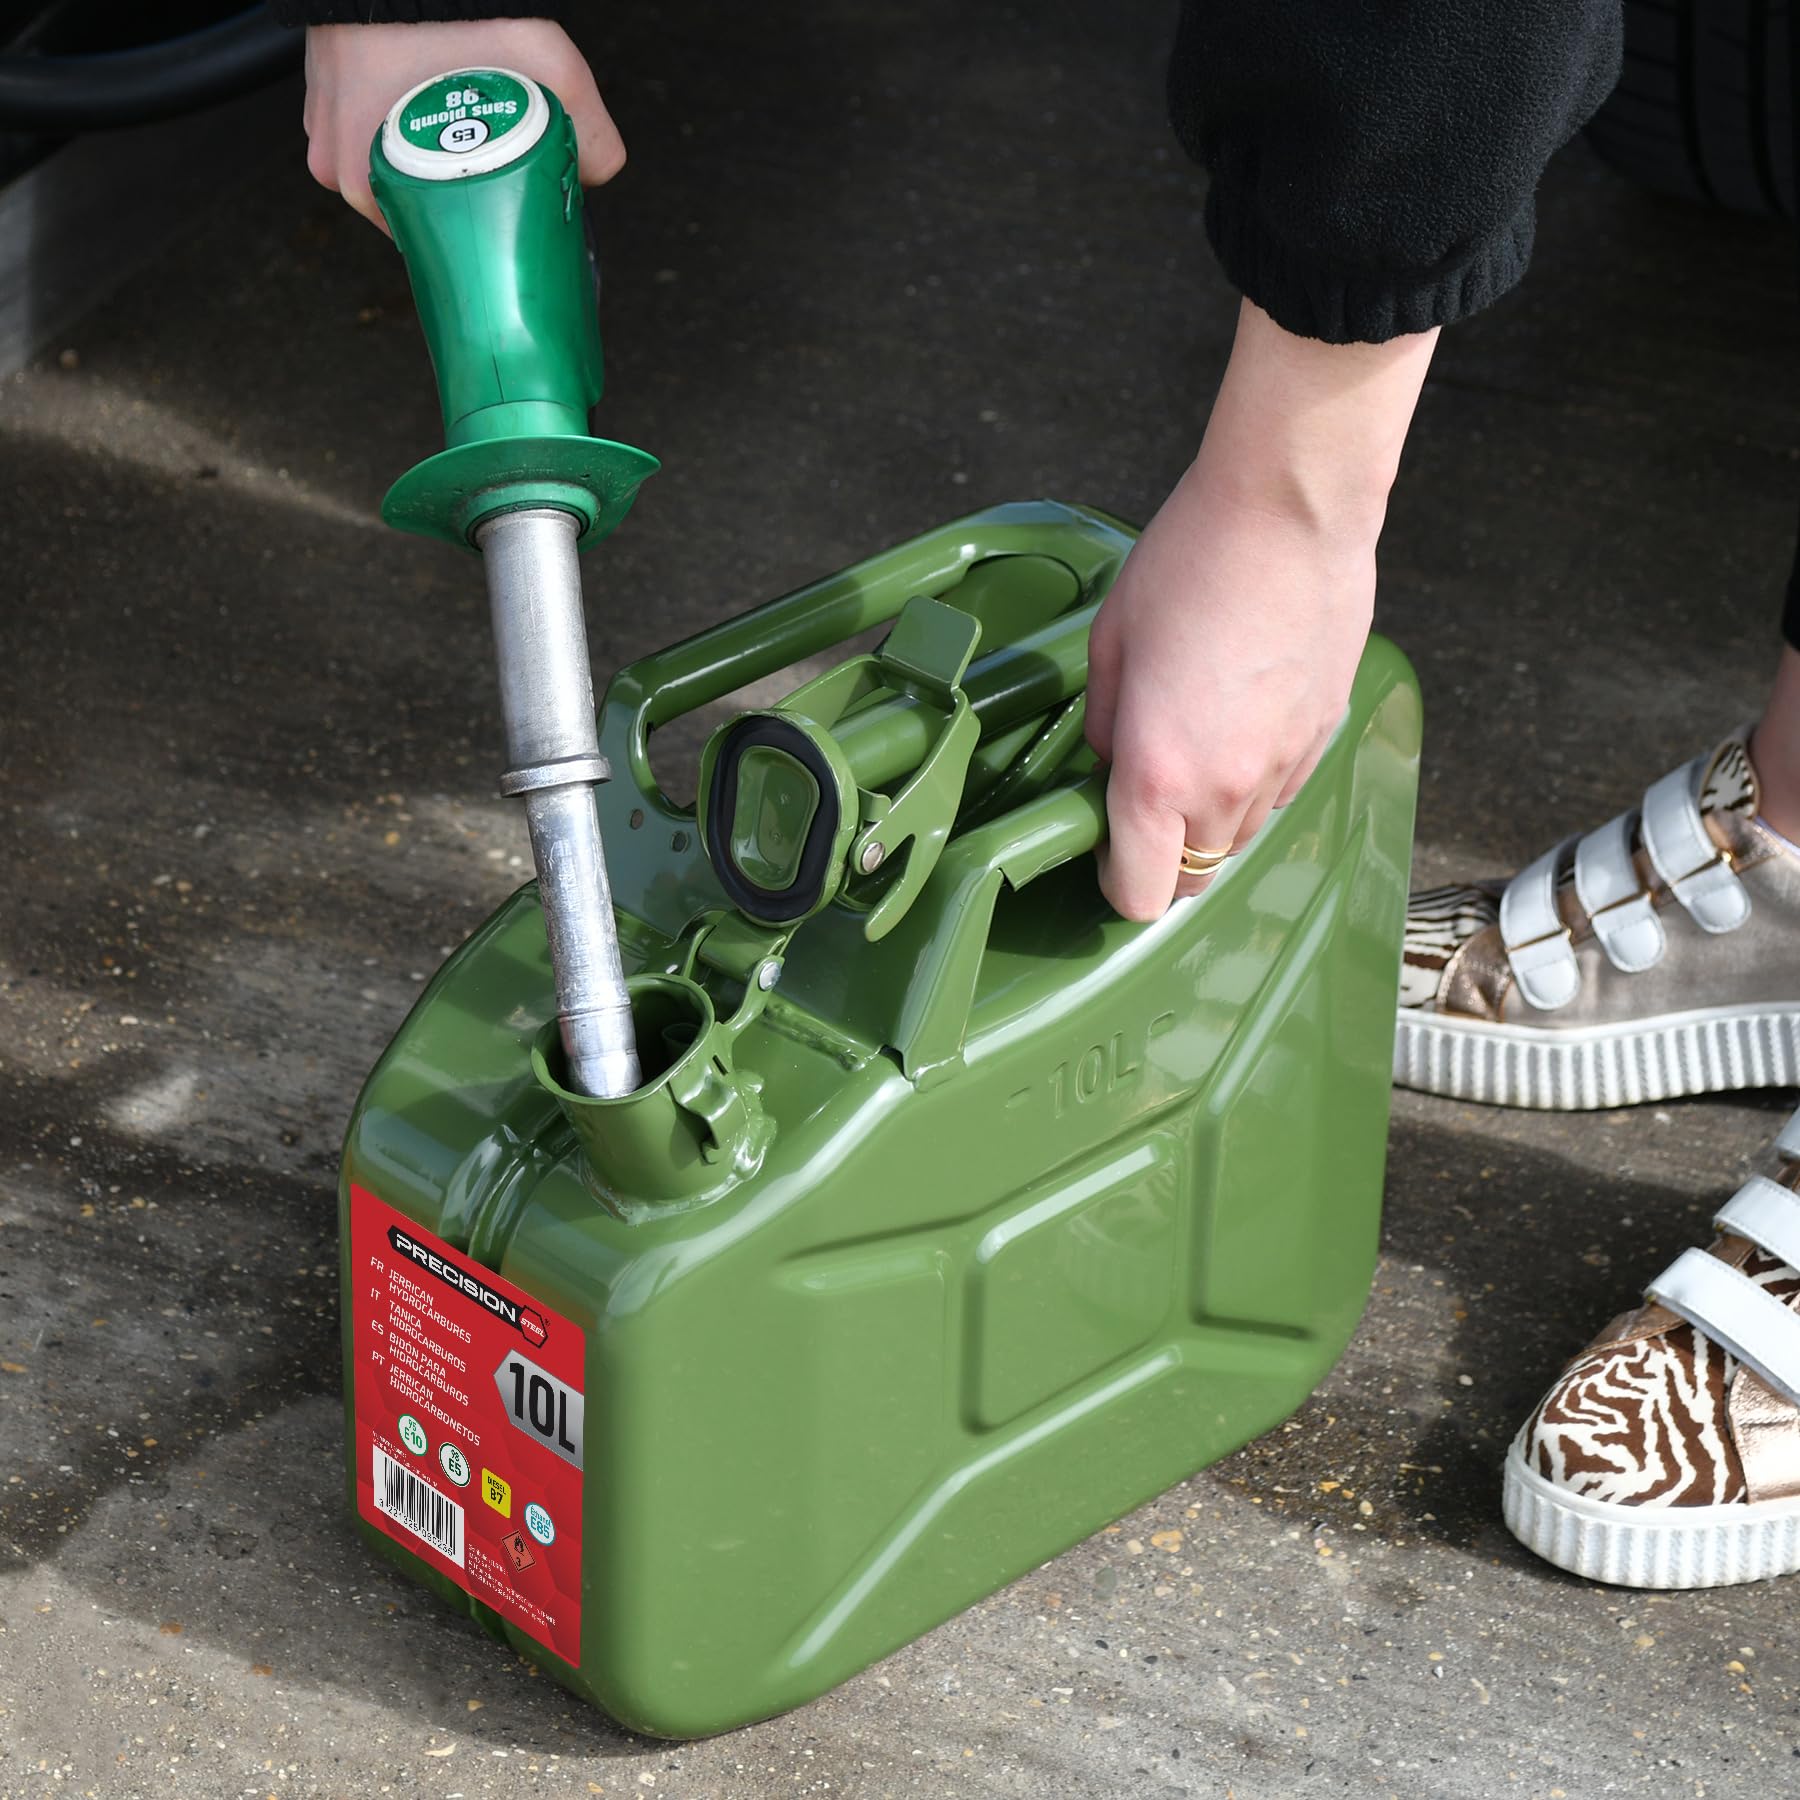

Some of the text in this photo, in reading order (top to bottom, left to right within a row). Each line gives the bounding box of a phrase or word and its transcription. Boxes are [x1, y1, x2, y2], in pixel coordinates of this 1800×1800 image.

[410, 100, 517, 132] Sans plomb
[446, 88, 480, 108] 98
[452, 128, 476, 143] E5
[1048, 1031, 1139, 1119] 10L
[370, 1256, 434, 1306] FR JERRICAN
[396, 1233, 516, 1323] PRECISION
[370, 1288, 422, 1331] IT TANICA
[389, 1282, 472, 1344] HYDROCARBURES
[371, 1319, 446, 1379] ES BIDÓN PARA
[389, 1315, 466, 1373] HIDROCARBUROS
[372, 1351, 434, 1401] PT JERRICAN
[389, 1346, 469, 1407] HIDROCARBUROS
[389, 1377, 481, 1446] HIDROCARBONETOS
[408, 1419, 417, 1432] 95
[509, 1362, 576, 1455] 10L
[404, 1427, 423, 1449] E10
[448, 1458, 461, 1476] E5
[487, 1476, 506, 1495] DIESEL
[490, 1487, 503, 1505] B7
[530, 1515, 550, 1539] E85
[516, 1557, 521, 1567] 3
